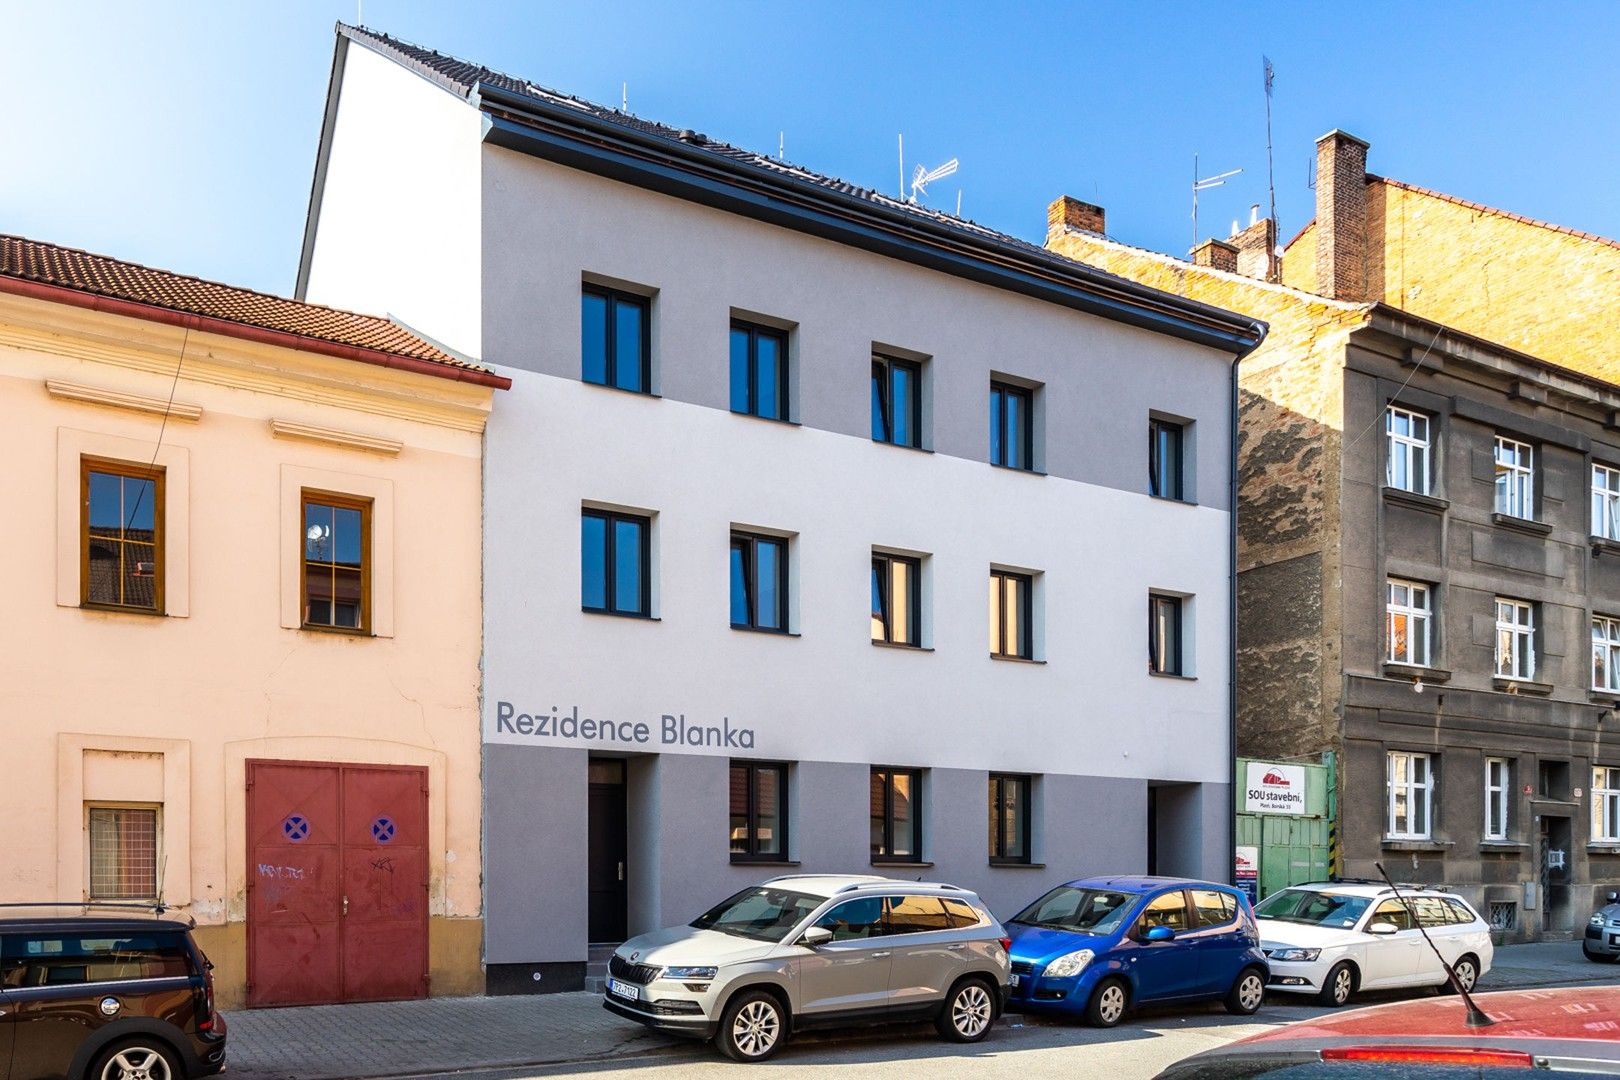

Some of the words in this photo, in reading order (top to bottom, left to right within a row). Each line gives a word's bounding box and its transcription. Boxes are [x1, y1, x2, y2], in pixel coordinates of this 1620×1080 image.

[497, 701, 650, 743] Rezidence
[661, 714, 755, 749] Blanka
[1248, 789, 1265, 800] SOU
[1266, 791, 1302, 803] stavební,
